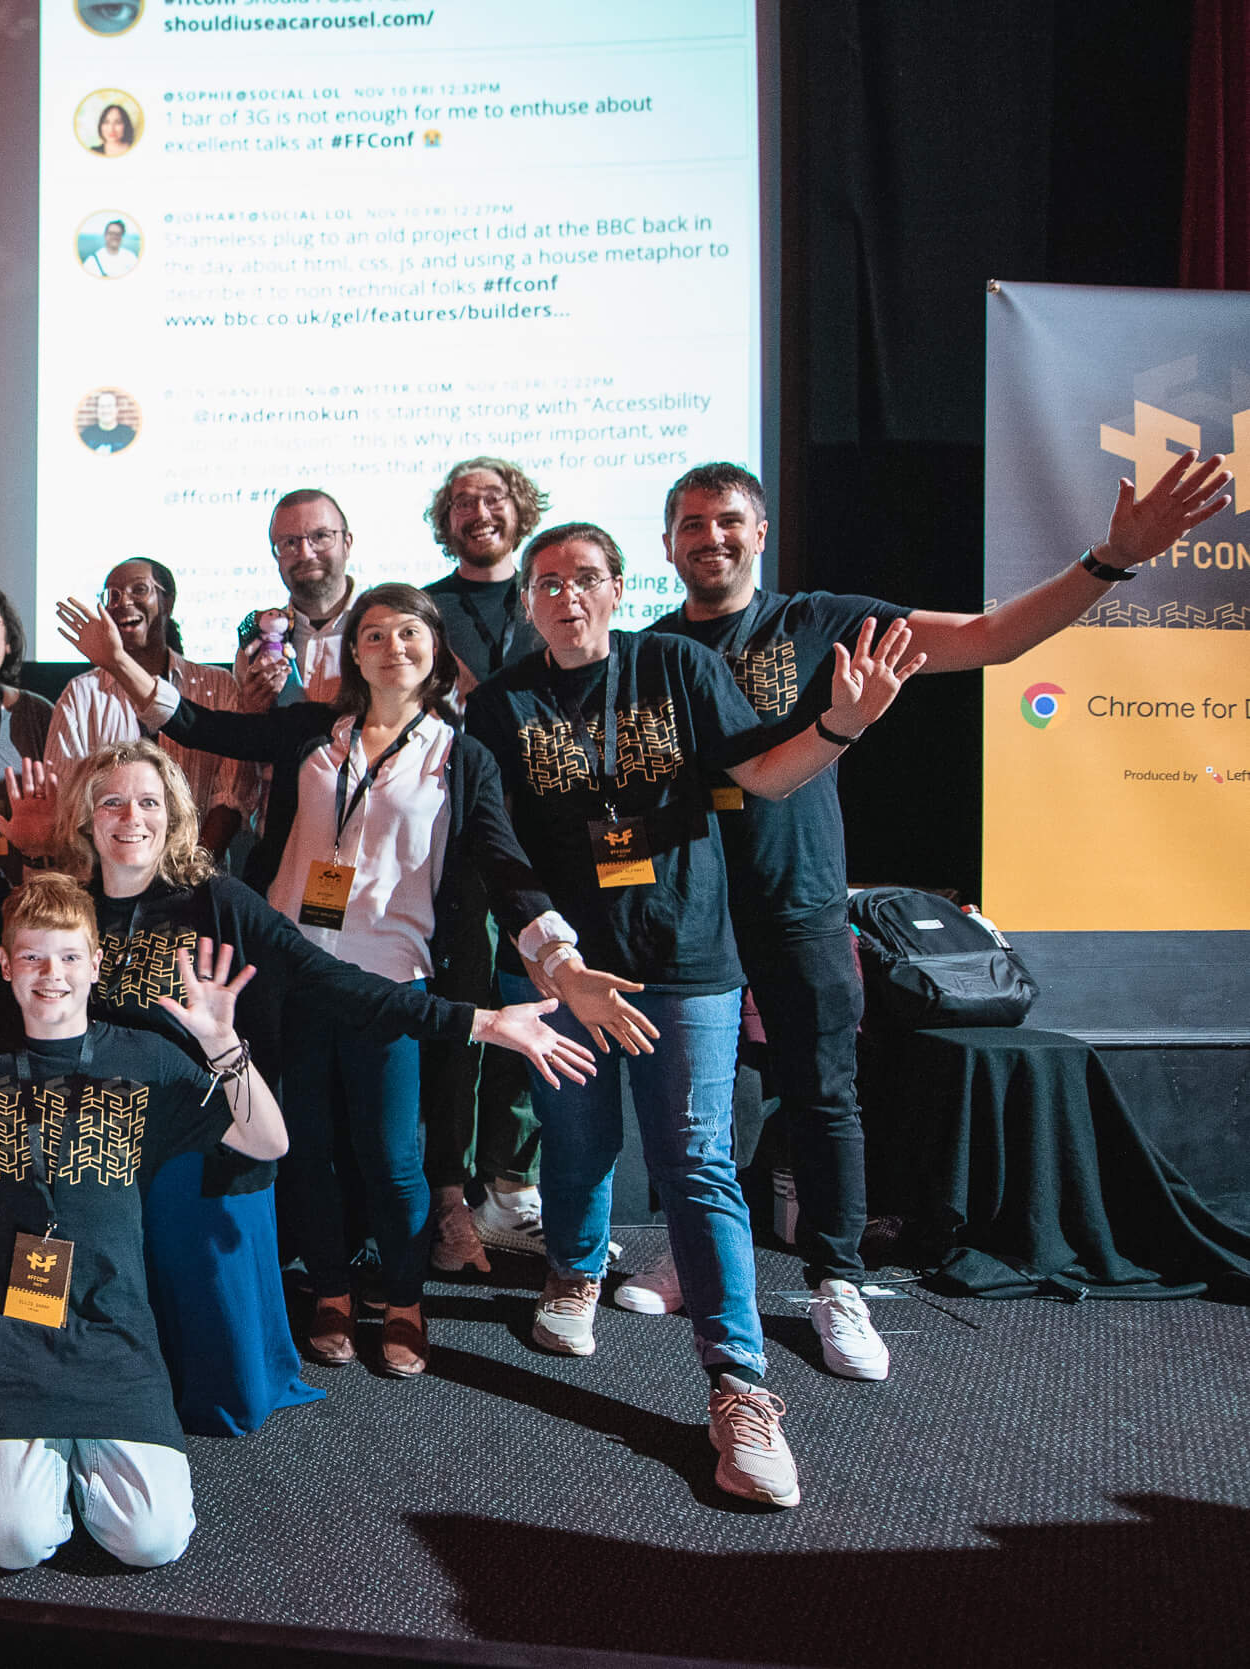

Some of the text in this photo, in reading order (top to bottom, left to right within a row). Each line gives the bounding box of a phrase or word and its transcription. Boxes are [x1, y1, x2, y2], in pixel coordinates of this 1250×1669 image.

[164, 9, 435, 32] shouldiuseacarousel.com/
[354, 86, 385, 98] NOV
[391, 86, 407, 97] 10
[412, 84, 434, 96] FRI
[182, 111, 212, 126] bar
[220, 109, 239, 126] of
[246, 110, 270, 126] 3G
[278, 108, 291, 125] is
[297, 108, 329, 124] not
[335, 106, 408, 127] enough
[414, 104, 442, 121] for
[448, 106, 478, 119] me
[483, 102, 505, 118] to
[509, 97, 590, 118] enthuse
[595, 95, 654, 114] about
[164, 131, 415, 152] excellent talks at #FFConf
[164, 231, 266, 249] Shameless
[273, 231, 315, 251] plug
[320, 230, 340, 246] to
[345, 231, 369, 245] an
[375, 228, 406, 244] old
[411, 225, 479, 247] project
[496, 223, 527, 240] did
[533, 224, 552, 239] at
[558, 219, 591, 237] the
[596, 217, 638, 236] BBC
[642, 215, 688, 233] back
[694, 214, 713, 231] in
[421, 250, 458, 270] and
[464, 250, 517, 272] using
[521, 254, 533, 268] a
[538, 247, 600, 265] house
[605, 242, 703, 265] metaphor
[709, 241, 730, 258] to
[338, 279, 426, 298] technical
[431, 276, 477, 296] folks
[483, 273, 559, 293] #ffconf
[192, 405, 360, 425] @ireaderinokun
[385, 403, 462, 424] starting
[467, 399, 530, 422] strong
[535, 397, 578, 416] with
[414, 427, 454, 449] why
[458, 427, 481, 446] its
[487, 428, 543, 448] super
[549, 422, 654, 446] important,
[659, 422, 689, 438] we
[386, 456, 424, 473] that
[431, 458, 455, 473] ar
[559, 451, 588, 471] for
[593, 452, 627, 469] our
[634, 448, 688, 467] users
[1087, 695, 1195, 718] Chrome
[1202, 697, 1238, 719] for
[1124, 769, 1180, 782] Produced
[1183, 770, 1198, 783] by
